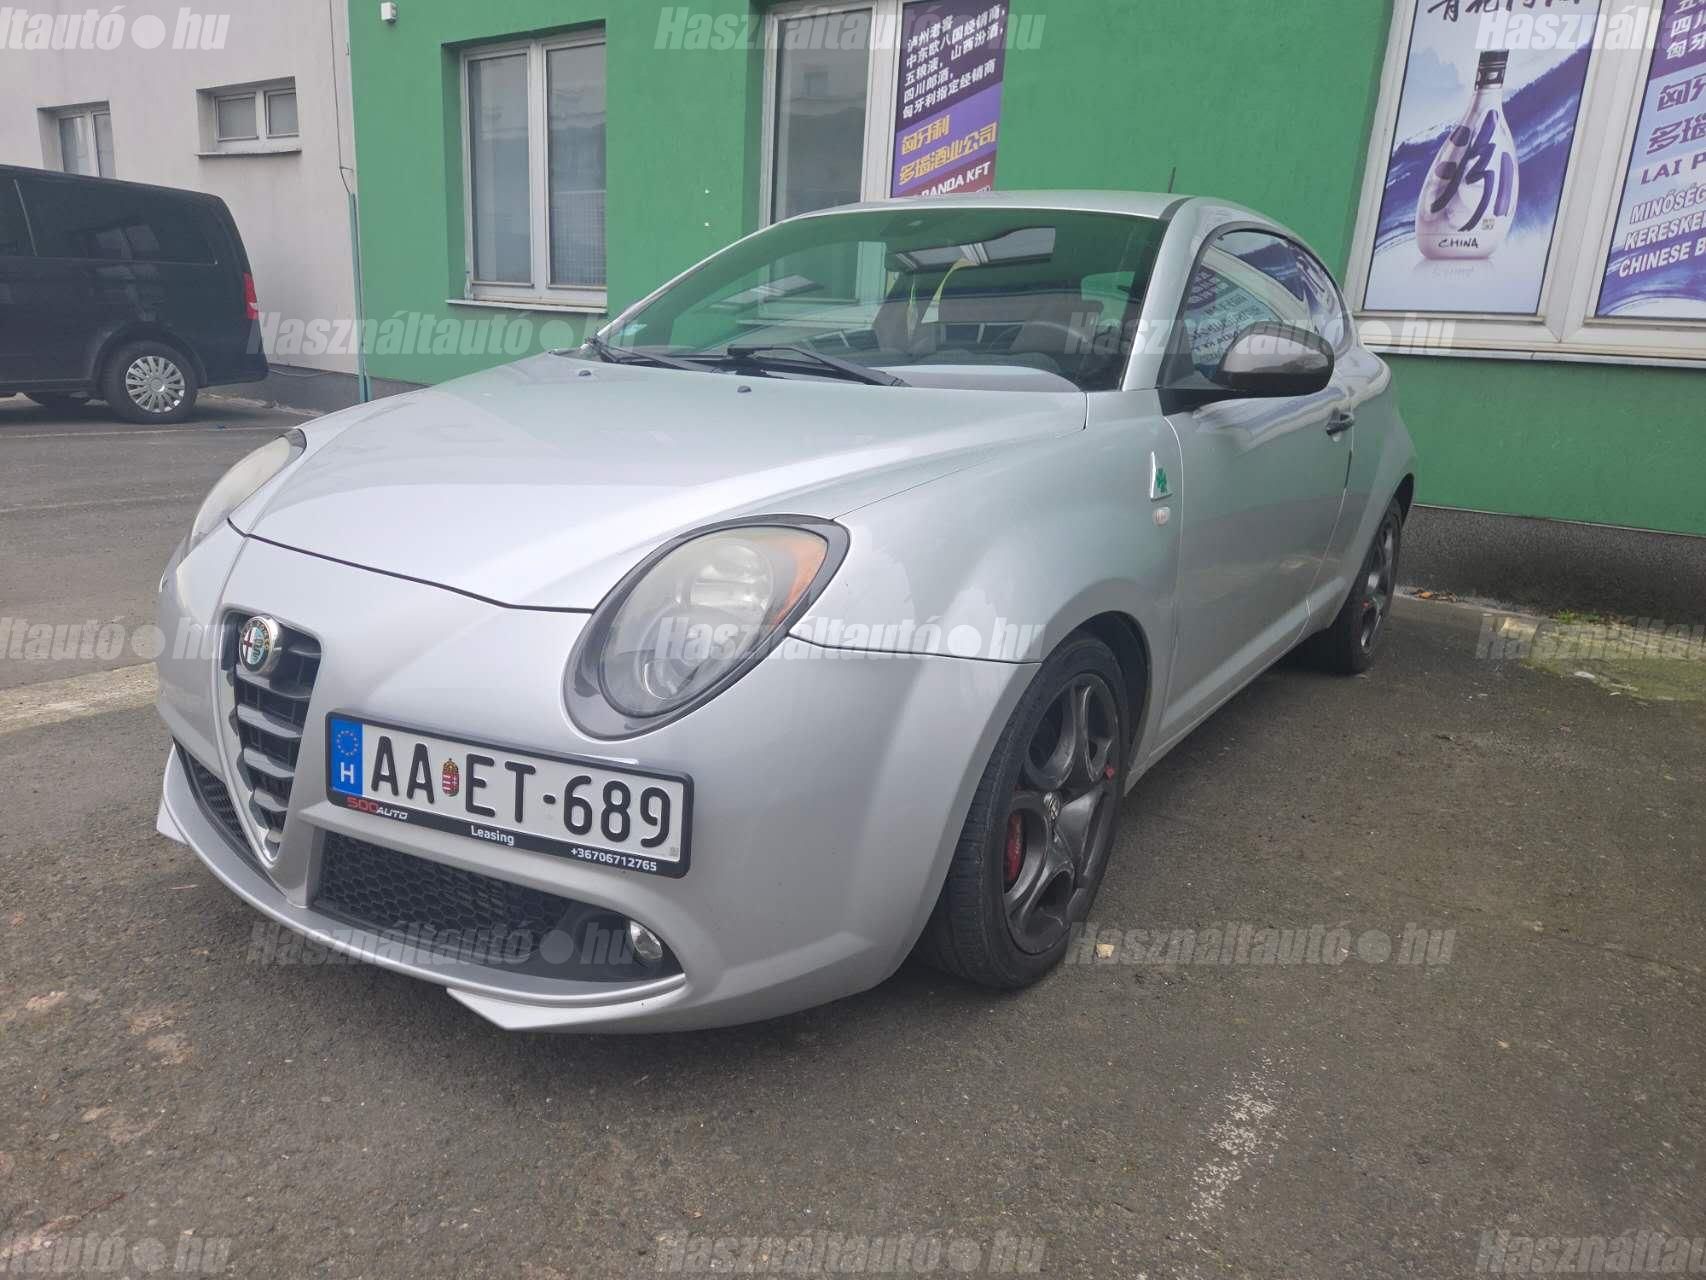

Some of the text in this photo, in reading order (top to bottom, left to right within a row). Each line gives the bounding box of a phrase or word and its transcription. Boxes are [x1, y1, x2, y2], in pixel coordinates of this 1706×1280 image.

[966, 161, 991, 183] KFT
[1641, 160, 1682, 185] LAI
[1438, 237, 1479, 248] CHINA
[1619, 241, 1692, 277] CHINESE
[340, 762, 354, 785] H
[471, 825, 515, 847] Leasing
[571, 847, 657, 872] +36706712765
